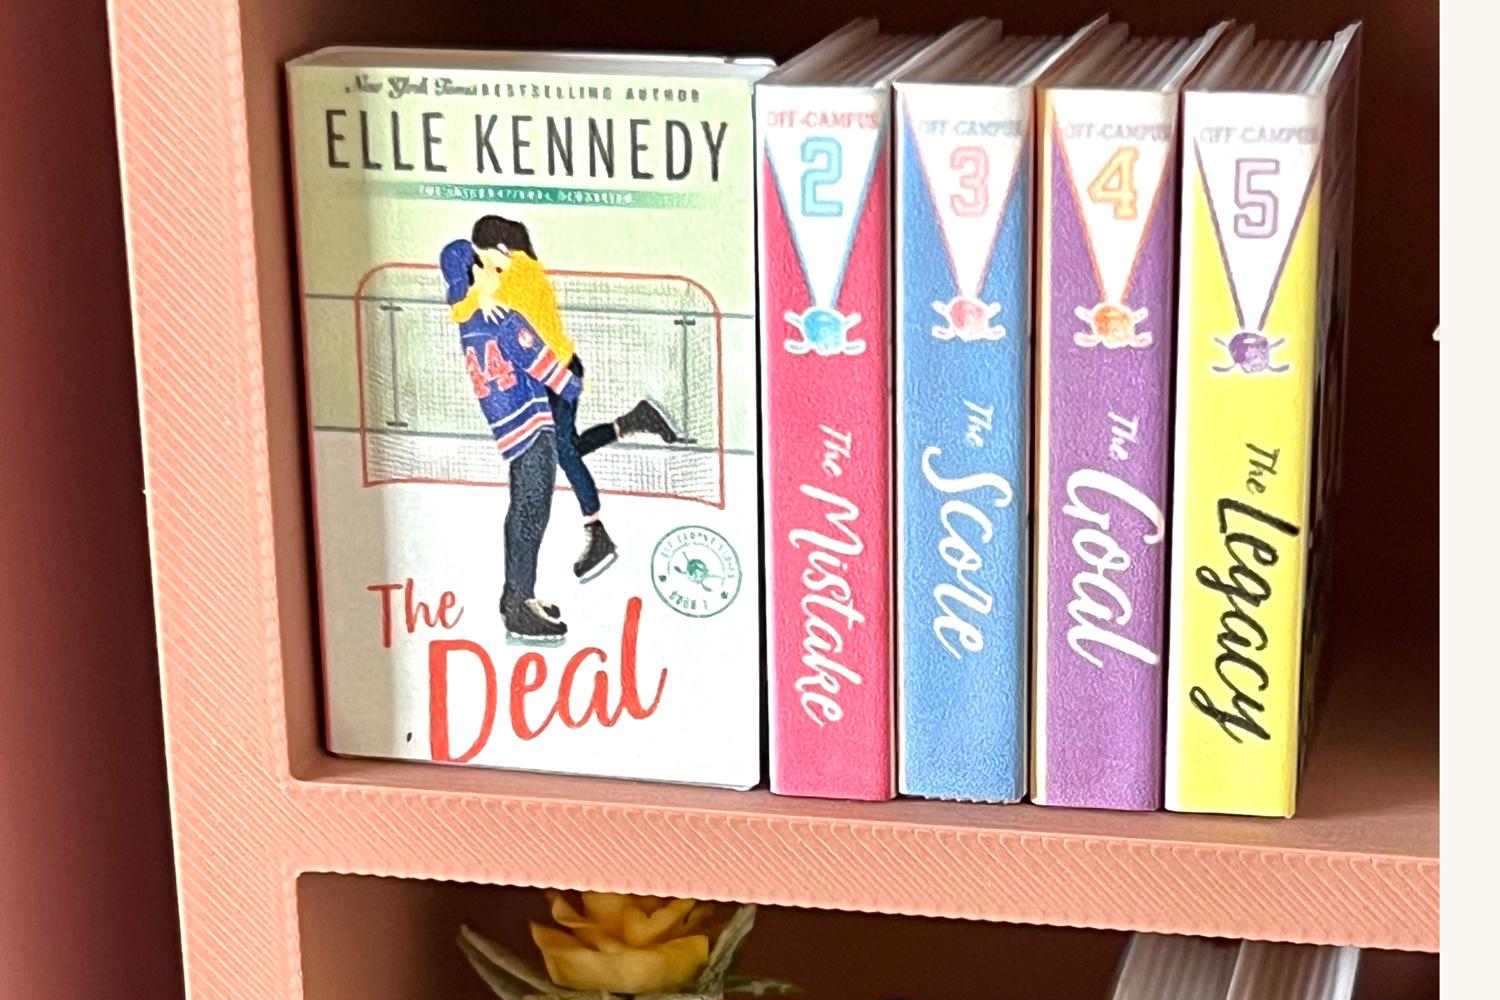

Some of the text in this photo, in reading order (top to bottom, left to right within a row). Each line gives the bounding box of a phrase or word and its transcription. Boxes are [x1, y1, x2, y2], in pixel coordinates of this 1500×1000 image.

[325, 108, 729, 182] ELLE KENNEDY
[799, 135, 843, 217] 2
[949, 145, 990, 217] 3
[1086, 146, 1139, 221] 4
[1232, 157, 1280, 239] 5
[921, 399, 1014, 661] The Score
[1062, 410, 1166, 668] The Goal
[367, 577, 464, 648] The
[790, 423, 862, 727] The Mistake
[1188, 442, 1300, 744] The Legacy
[428, 596, 667, 762] Deal
